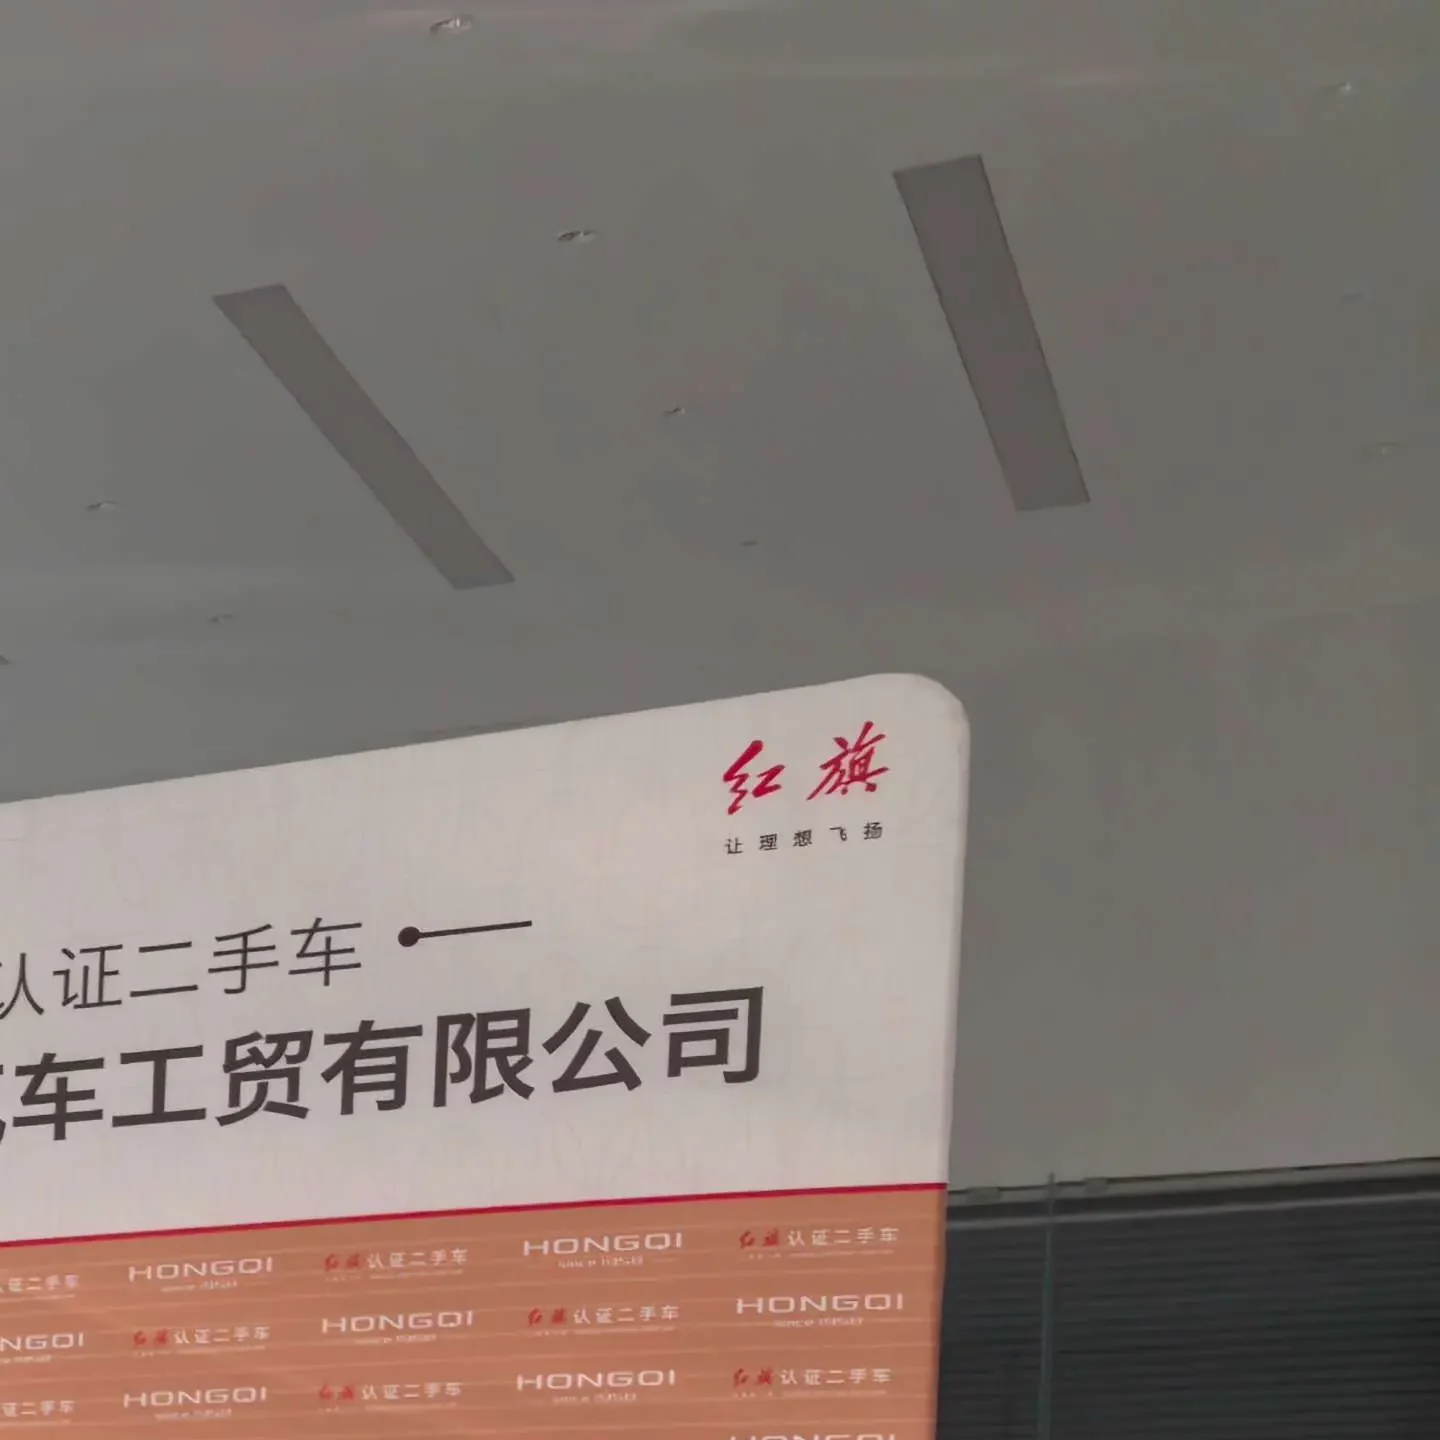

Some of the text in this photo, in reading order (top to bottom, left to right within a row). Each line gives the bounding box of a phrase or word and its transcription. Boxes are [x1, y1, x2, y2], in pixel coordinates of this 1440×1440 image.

[722, 720, 890, 815] 红旗
[723, 821, 884, 856] 让理想飞扬
[522, 1231, 683, 1257] HONGQI
[128, 1256, 273, 1283] HONGQI
[736, 1292, 904, 1315] HONGQI
[321, 1309, 474, 1334] HONGQI
[516, 1368, 676, 1391] HONGQI
[123, 1386, 267, 1409] HONGQI
